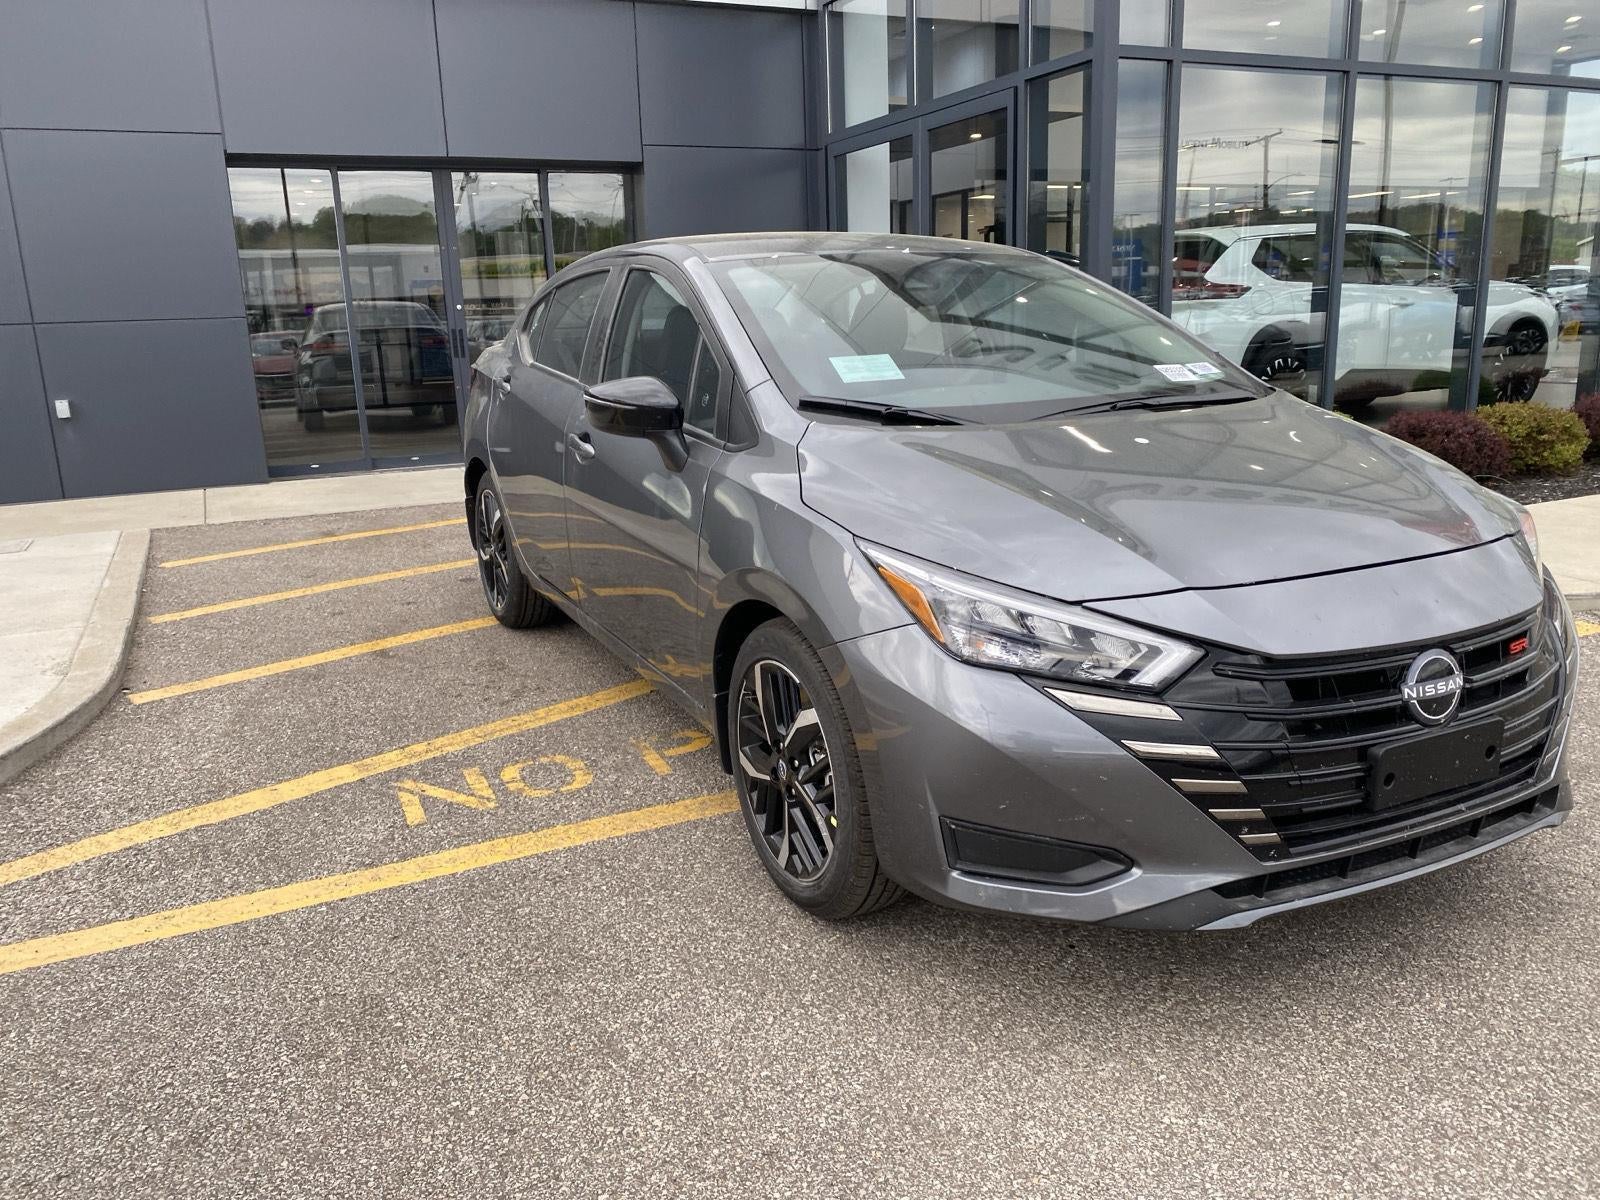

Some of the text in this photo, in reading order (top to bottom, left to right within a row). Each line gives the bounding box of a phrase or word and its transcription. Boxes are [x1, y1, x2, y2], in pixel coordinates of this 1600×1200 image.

[1509, 638, 1529, 655] SR
[1403, 676, 1465, 700] NISSAN
[392, 753, 593, 828] NO
